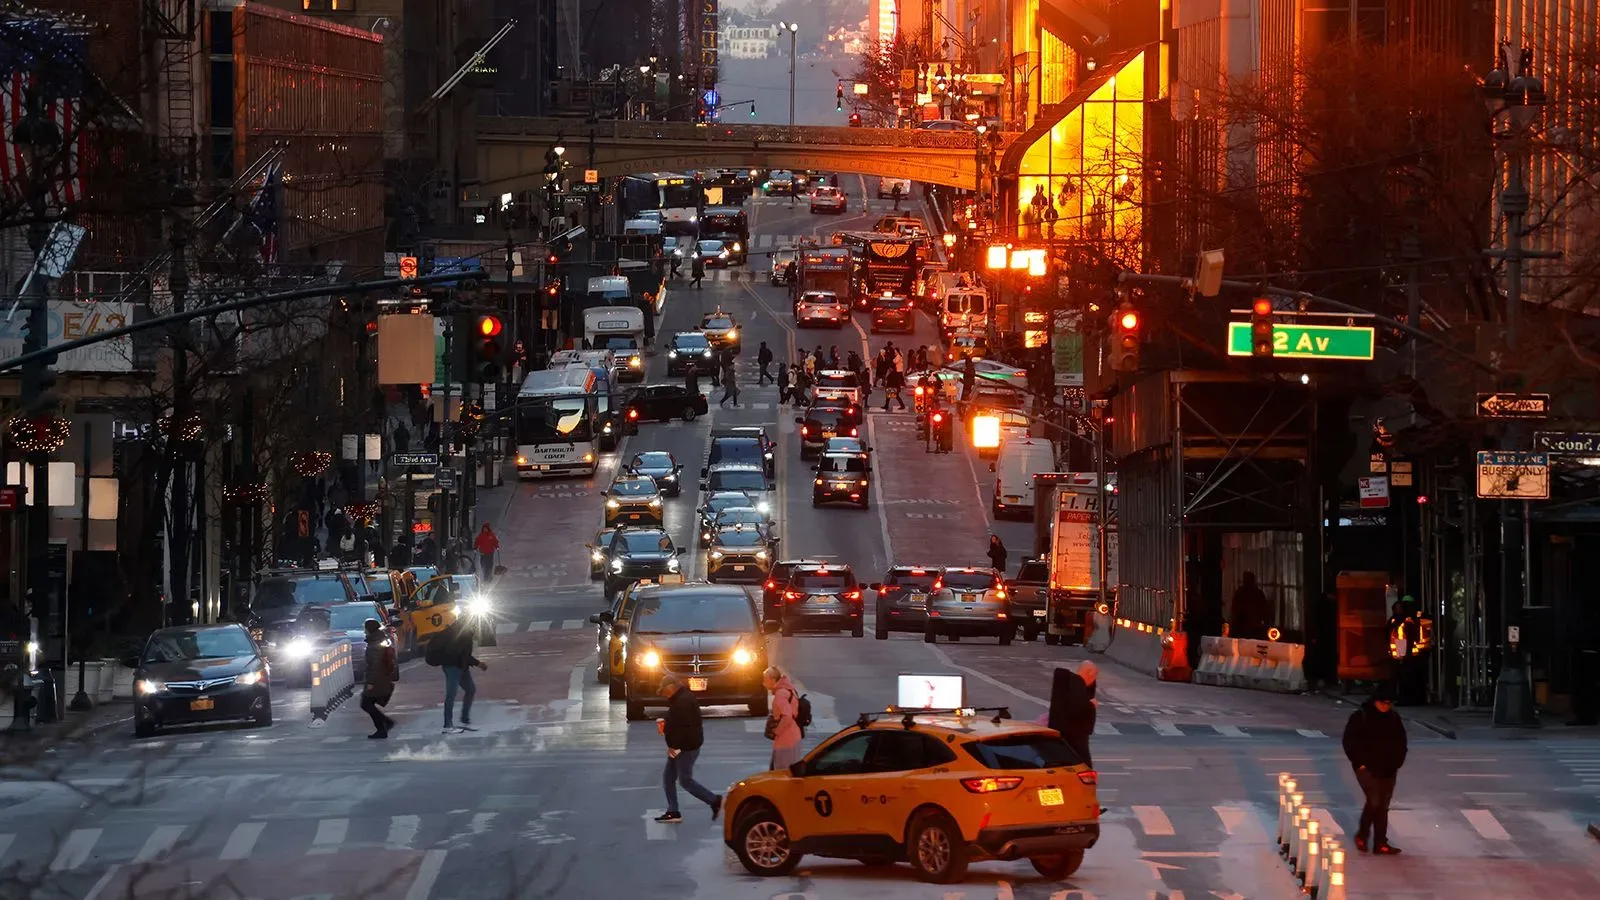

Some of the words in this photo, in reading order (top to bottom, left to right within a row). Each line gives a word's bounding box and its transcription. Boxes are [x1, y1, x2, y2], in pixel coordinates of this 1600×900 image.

[1272, 331, 1289, 351] 2
[1295, 332, 1330, 352] Av
[1519, 401, 1540, 410] WAY
[1482, 466, 1514, 475] BUSES
[1519, 467, 1544, 476] ONLY
[1066, 512, 1092, 521] PAPER
